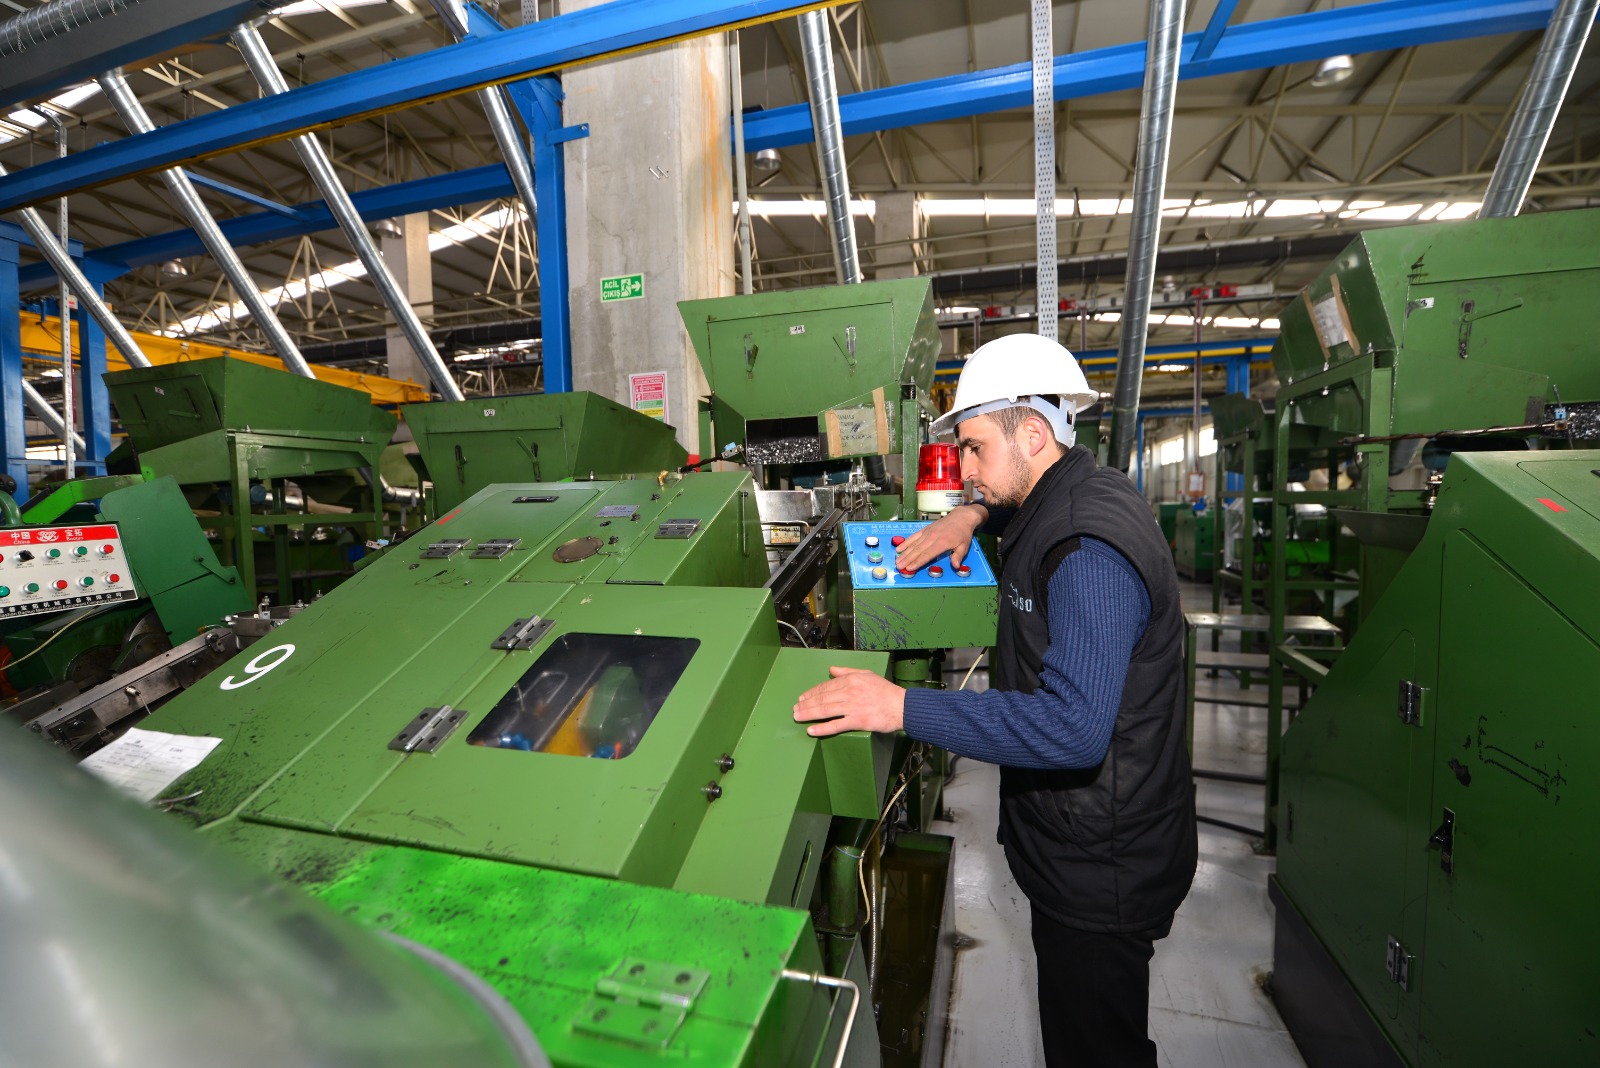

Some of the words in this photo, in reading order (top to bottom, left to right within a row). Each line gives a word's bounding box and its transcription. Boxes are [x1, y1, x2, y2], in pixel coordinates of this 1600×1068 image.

[603, 290, 620, 299] ÇIKIŞ
[11, 532, 31, 540] 中国
[65, 529, 83, 537] 宝拓
[219, 643, 296, 691] 9
